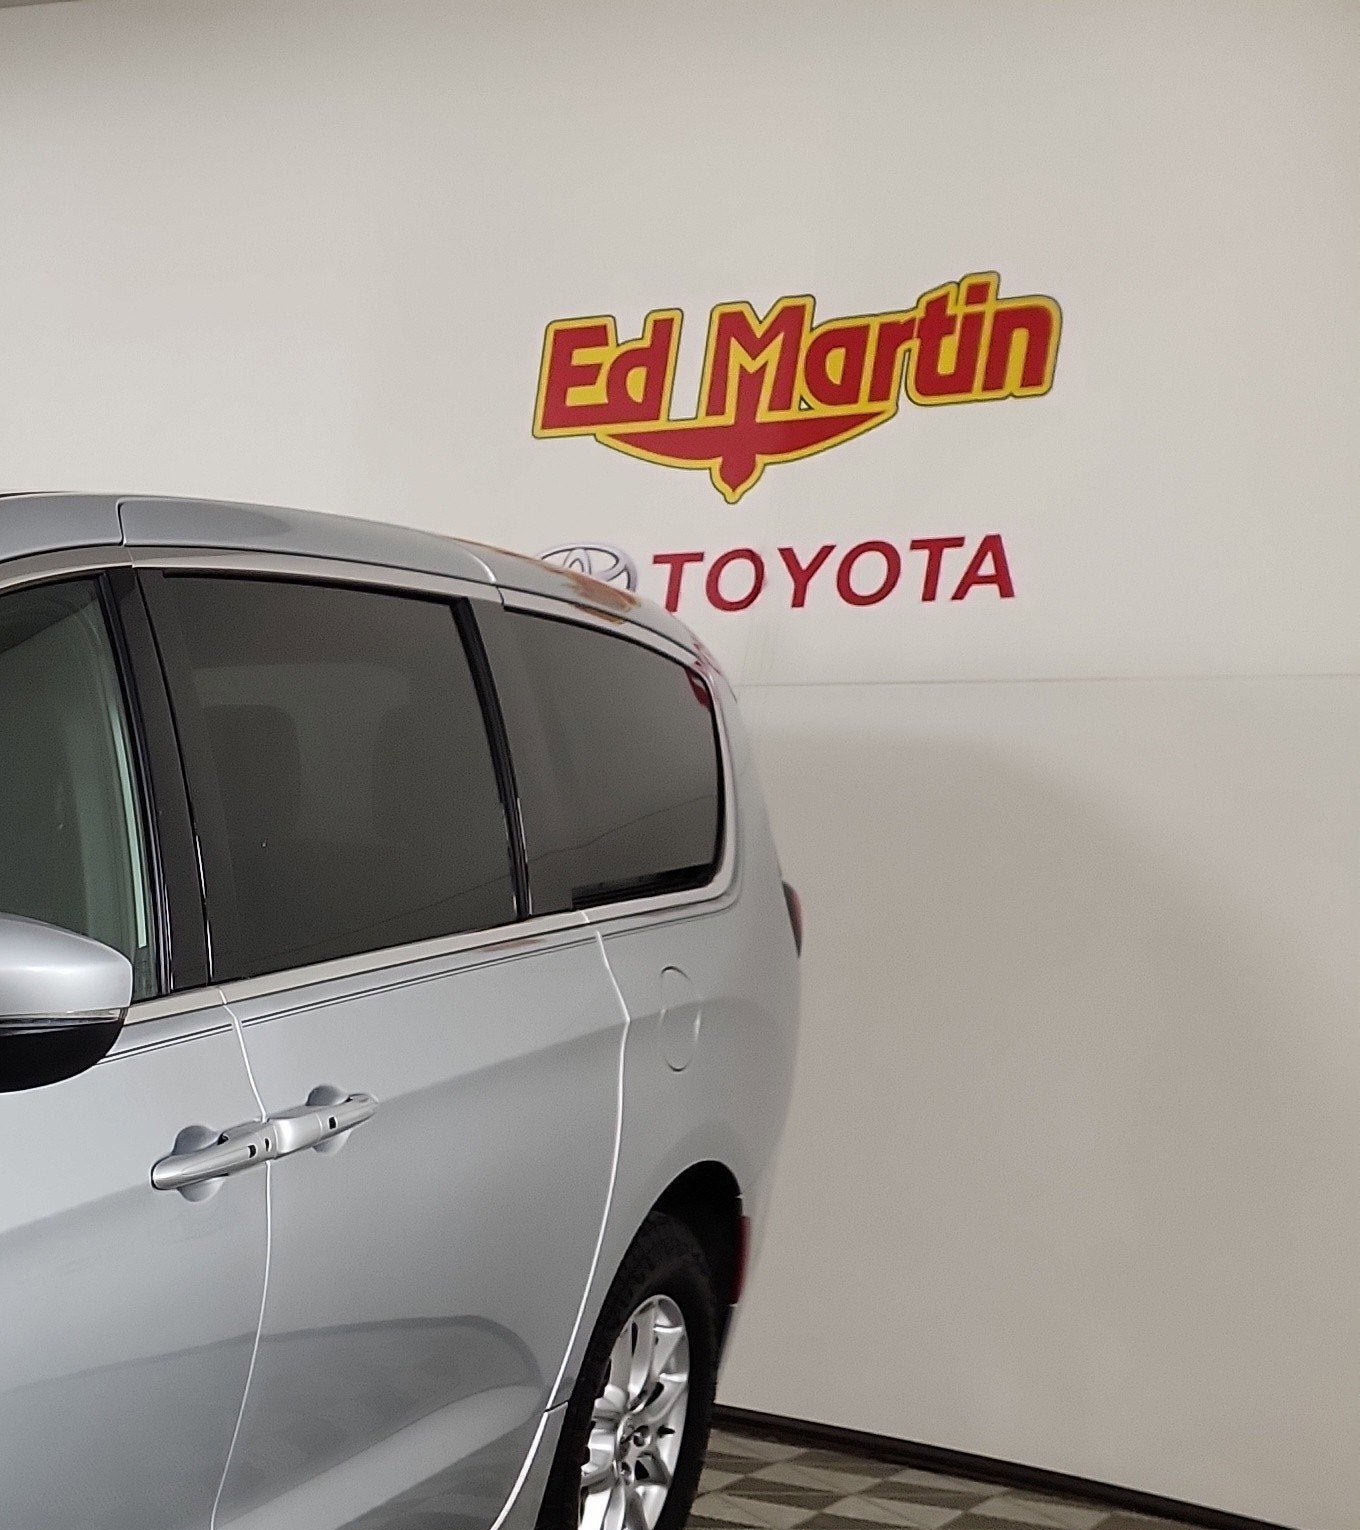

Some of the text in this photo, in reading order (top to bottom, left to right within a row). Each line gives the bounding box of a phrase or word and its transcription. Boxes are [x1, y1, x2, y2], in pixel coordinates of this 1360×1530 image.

[537, 278, 1059, 432] Ed Martin
[651, 533, 1016, 614] TOYOTA
